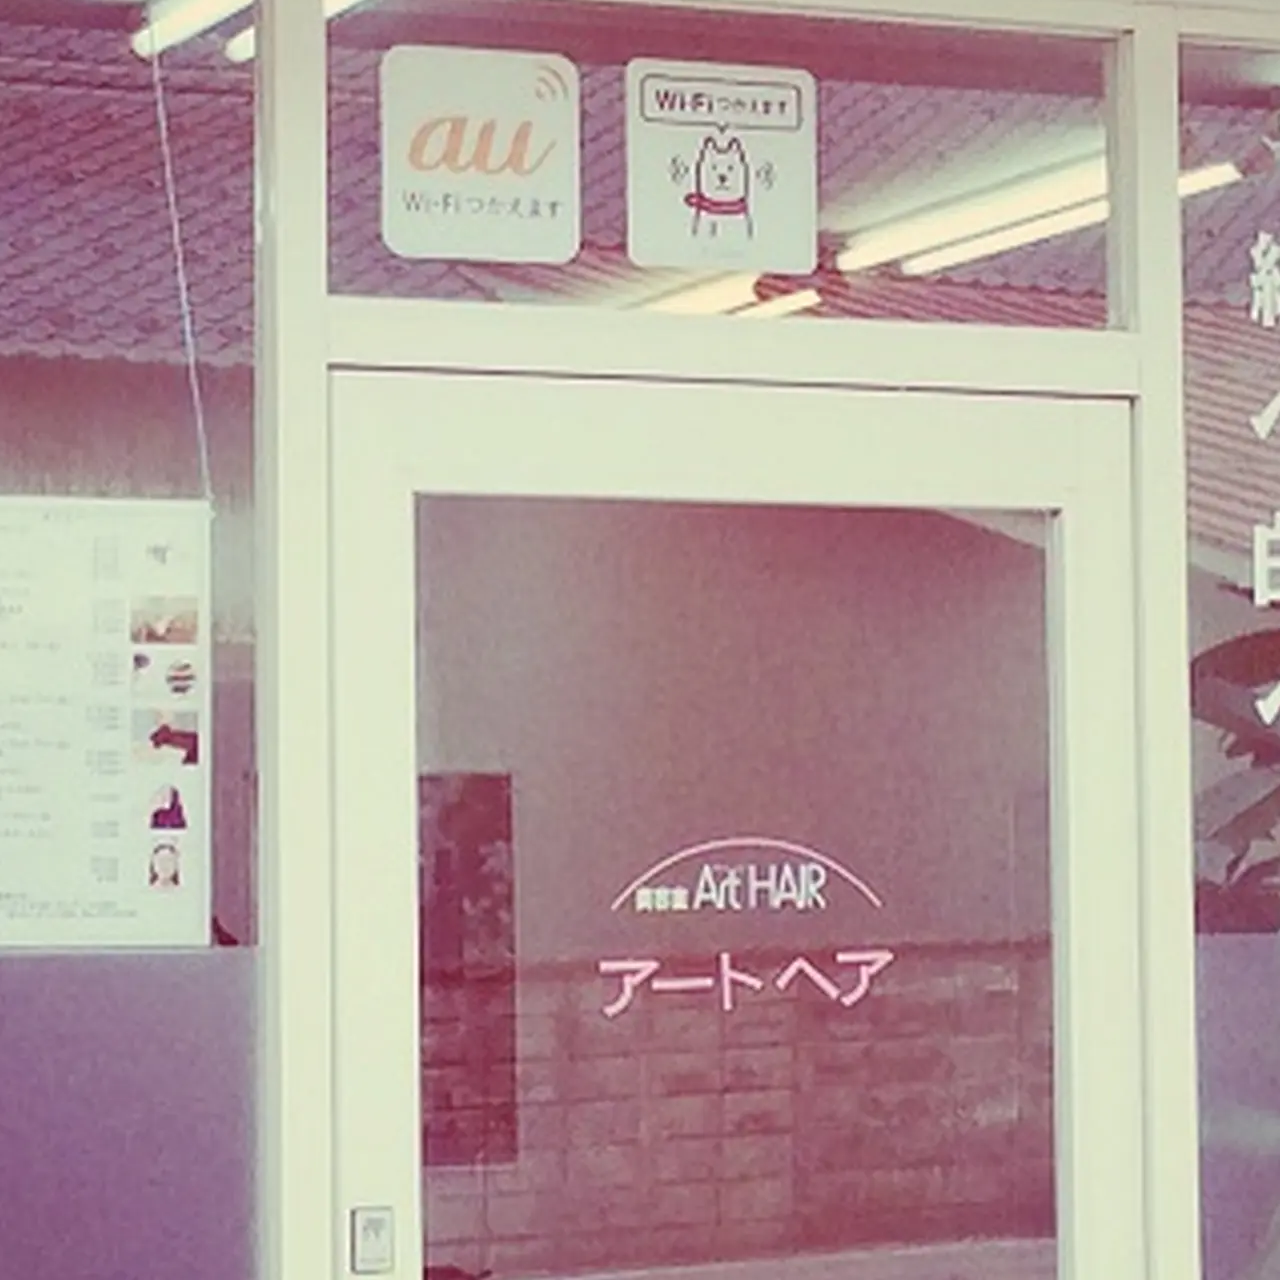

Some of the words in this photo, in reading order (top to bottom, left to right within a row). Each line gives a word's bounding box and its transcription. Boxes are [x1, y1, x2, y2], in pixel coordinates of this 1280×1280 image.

[405, 115, 556, 177] au
[692, 862, 742, 911] Art
[748, 861, 827, 911] HAIR
